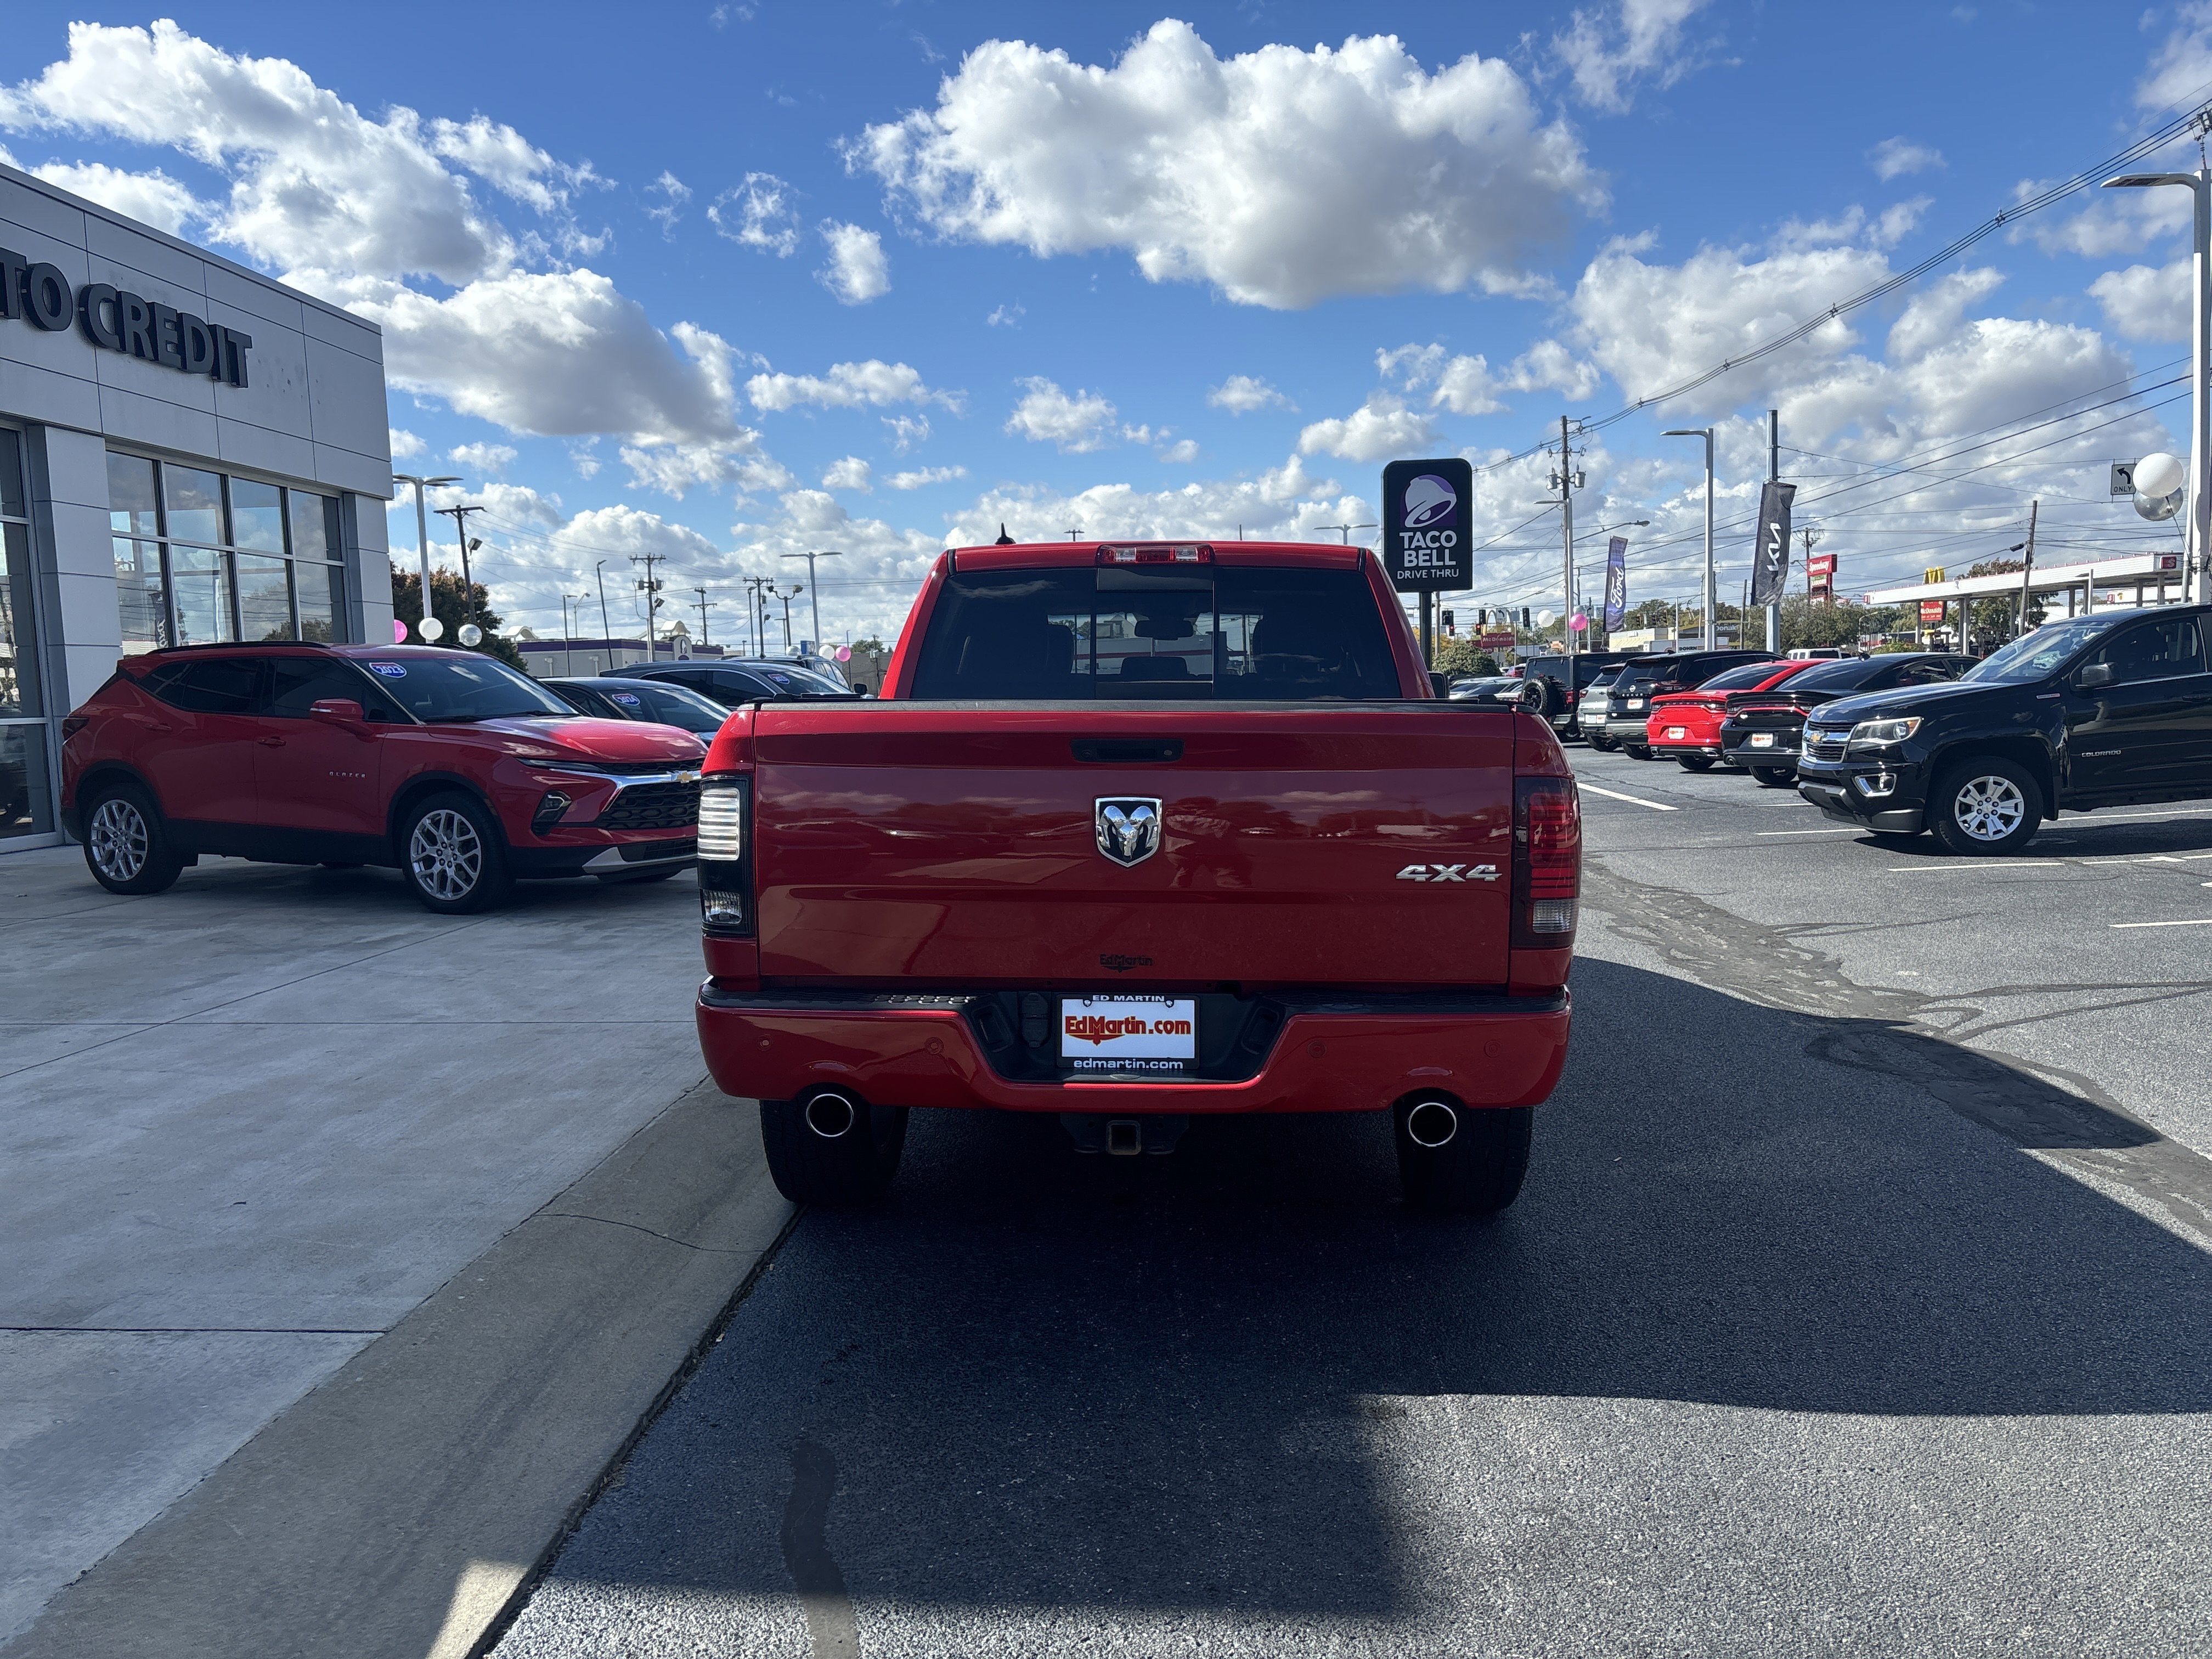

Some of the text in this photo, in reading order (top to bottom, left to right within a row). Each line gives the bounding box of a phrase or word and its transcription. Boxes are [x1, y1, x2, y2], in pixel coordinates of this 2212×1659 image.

[78, 283, 252, 388] CREDIT
[1399, 530, 1457, 549] TACO
[1404, 549, 1457, 567] BELL
[1397, 568, 1459, 579] DRIVE THRU
[1610, 566, 1624, 608] Ford
[376, 665, 404, 674] 2023
[1065, 1016, 1191, 1036] EdMartin.com
[1073, 1058, 1183, 1069] edmartin.com
